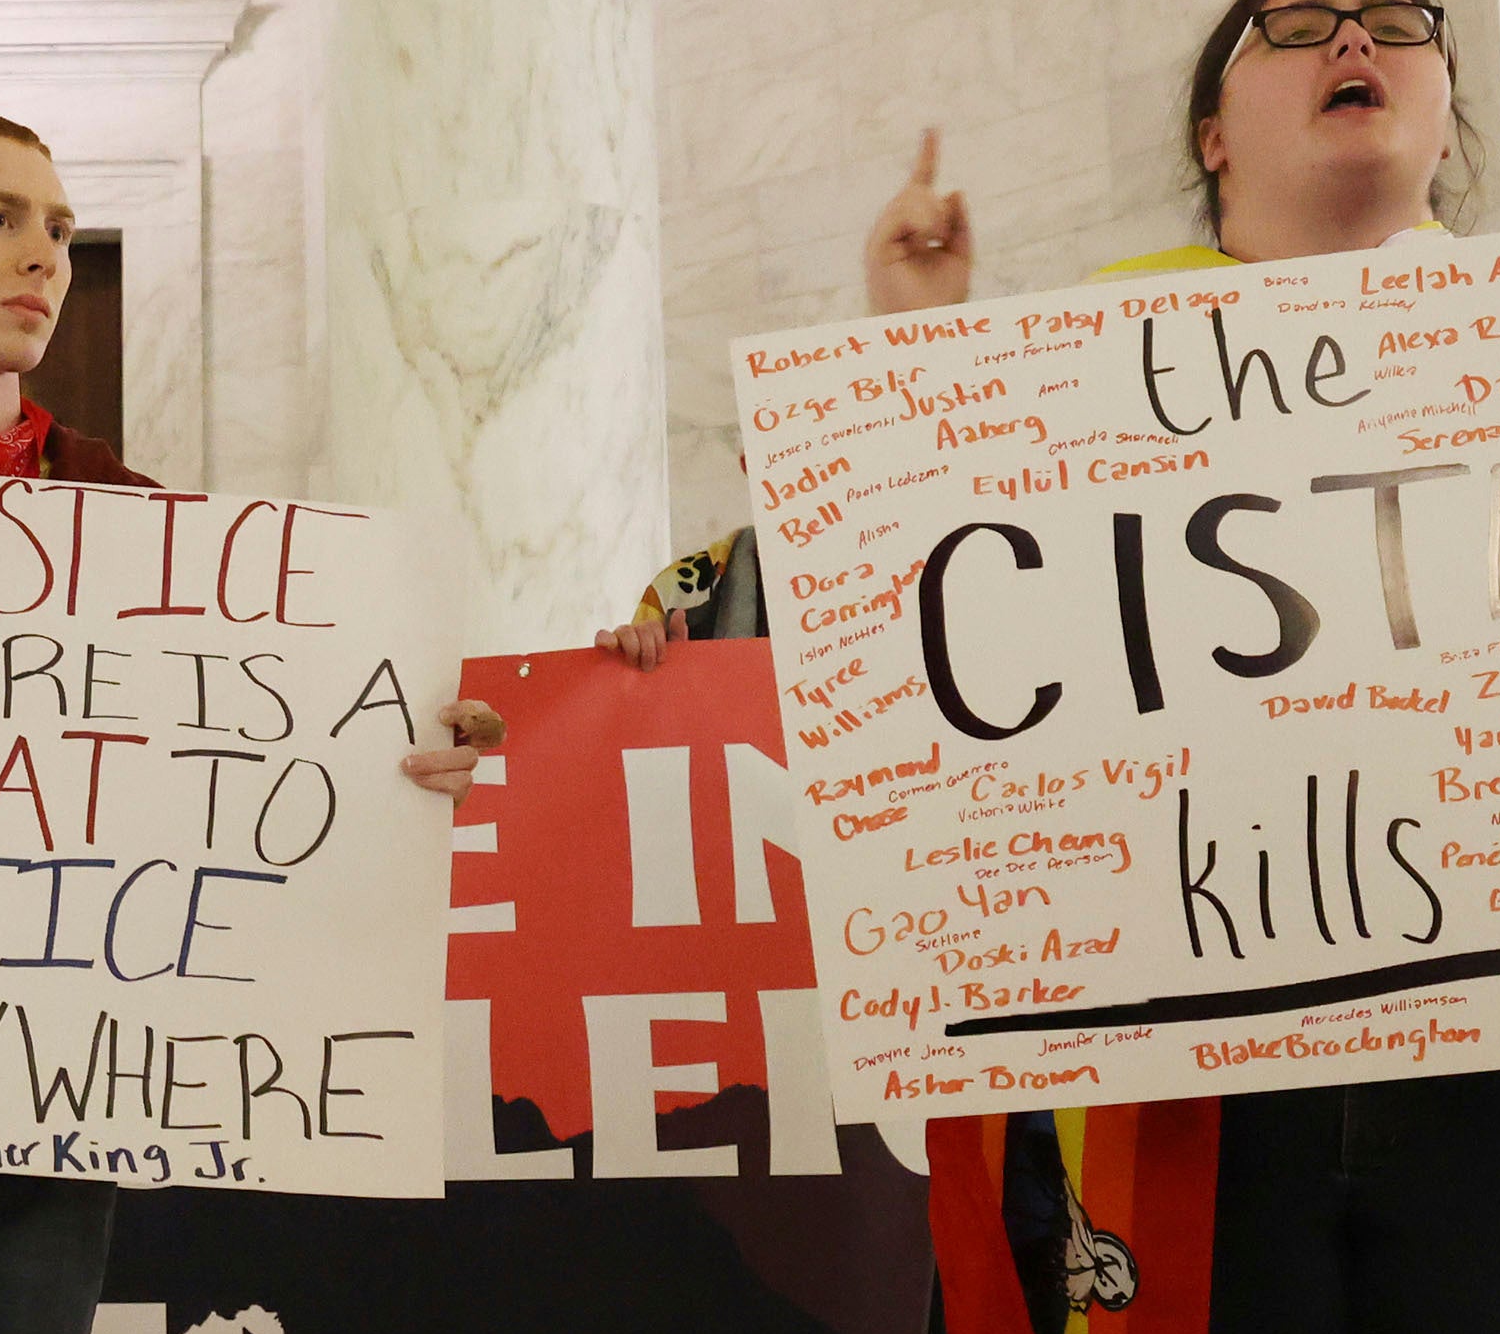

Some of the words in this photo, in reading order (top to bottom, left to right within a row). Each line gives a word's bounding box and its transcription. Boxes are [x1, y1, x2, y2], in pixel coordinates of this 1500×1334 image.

[1361, 263, 1474, 296] Leelah
[747, 336, 871, 378] Robert
[885, 318, 991, 346] White
[1378, 327, 1459, 360] Alexa
[847, 367, 926, 401] Bilir
[1143, 307, 1372, 436] the
[899, 378, 1006, 421] Justin
[761, 456, 851, 510] Jadin
[778, 502, 843, 548] Bell
[790, 563, 875, 600] Dora
[162, 650, 295, 743] IS
[330, 658, 415, 747] A
[785, 658, 869, 710] Tyree
[1259, 682, 1357, 720] David
[798, 675, 928, 749] Williams
[970, 768, 1091, 802] Carlos
[1102, 747, 1190, 800] Vigil
[171, 748, 337, 866] TO
[903, 838, 998, 872] Leslie
[1179, 769, 1443, 959] kills
[956, 884, 1052, 918] Yan
[844, 907, 949, 956] Gao
[934, 946, 1028, 975] Doski
[1040, 927, 1121, 963] Azad
[840, 988, 921, 1031] Cody
[958, 978, 1086, 1011] Barker
[980, 1066, 1100, 1090] Brown
[52, 1130, 171, 1183] King
[195, 1139, 266, 1183] Jr.
